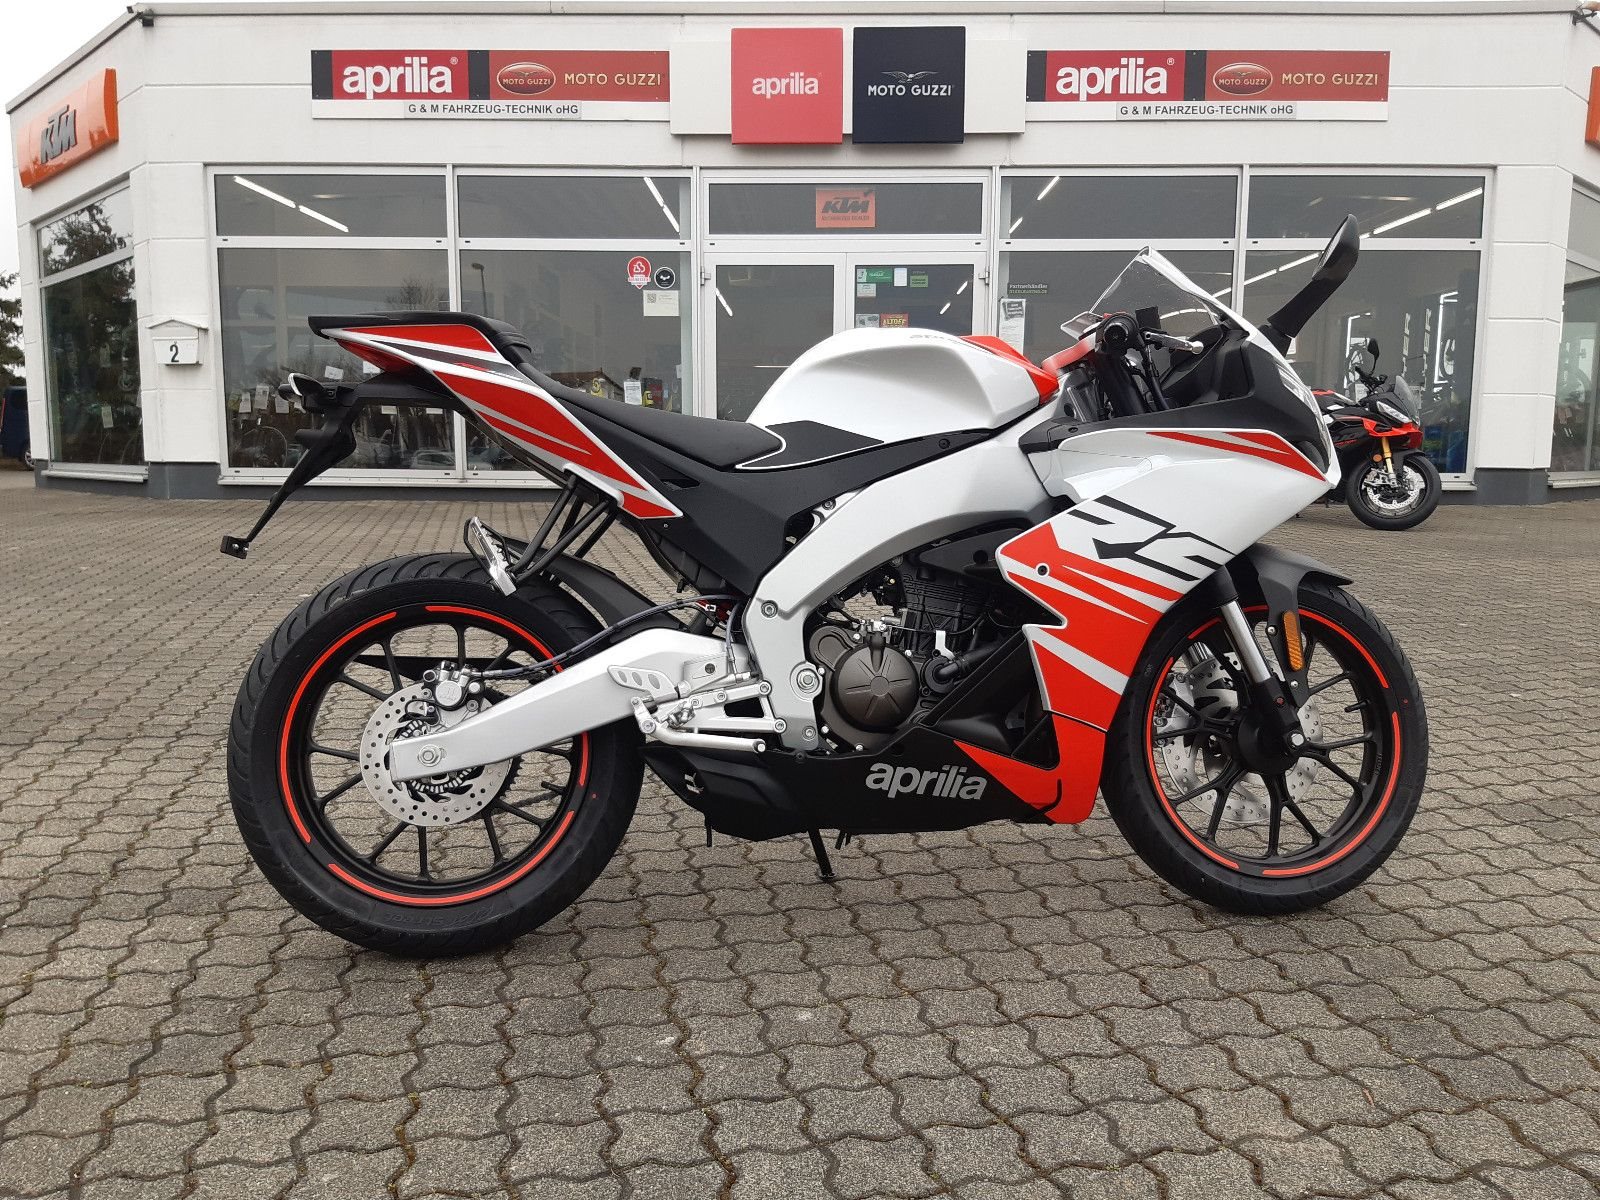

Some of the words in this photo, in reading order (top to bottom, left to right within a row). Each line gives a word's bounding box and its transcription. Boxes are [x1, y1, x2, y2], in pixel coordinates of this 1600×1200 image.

[342, 56, 453, 100] aprilia
[564, 73, 608, 85] MOTO
[614, 73, 661, 86] GUZZI
[751, 71, 819, 99] aprilia
[1055, 57, 1168, 101] aprilia
[1218, 78, 1241, 86] MOTO
[1243, 78, 1267, 86] GUZZI
[1281, 73, 1326, 85] MOTO
[1332, 73, 1378, 86] GUZZI
[867, 84, 906, 97] MOTO
[911, 84, 952, 97] GUZZI
[408, 104, 417, 113] G
[419, 104, 428, 113] &
[430, 104, 439, 113] M
[442, 104, 552, 114] FAHRZEUG-TECHNIK
[555, 104, 578, 114] oHG
[1120, 106, 1128, 115] G
[1131, 106, 1139, 115] &
[1142, 106, 1151, 115] M
[1155, 105, 1268, 115] FAHRZEUG-TECHNIK
[1271, 105, 1294, 115] oHG
[40, 104, 78, 165] KTM
[821, 196, 870, 213] KTM
[169, 344, 180, 363] 2
[865, 762, 988, 800] aprilia
